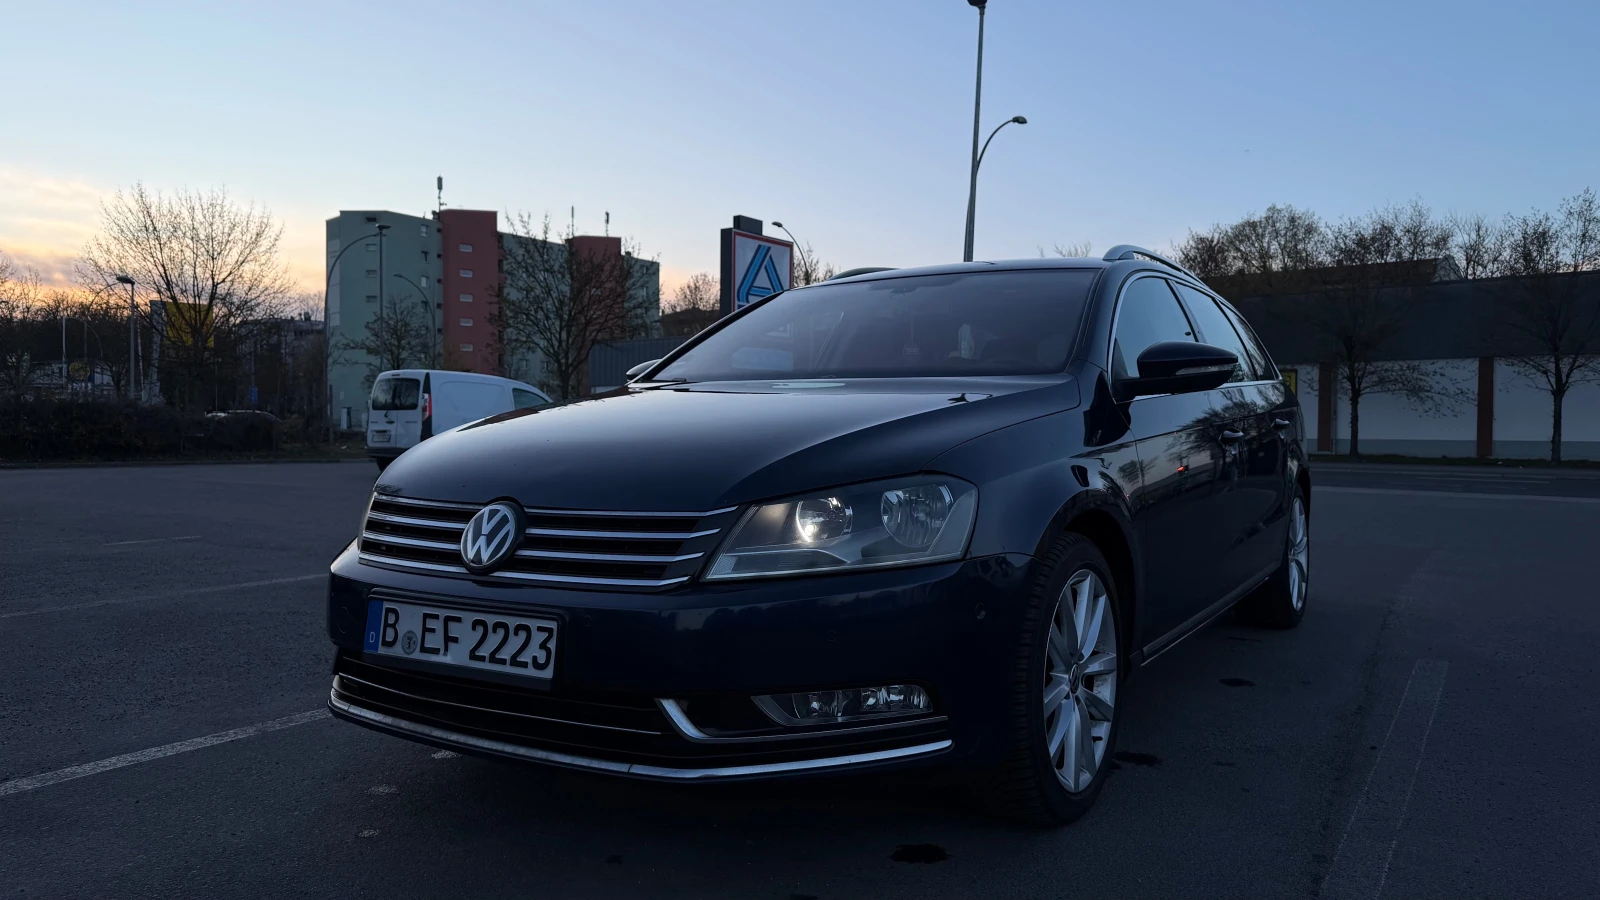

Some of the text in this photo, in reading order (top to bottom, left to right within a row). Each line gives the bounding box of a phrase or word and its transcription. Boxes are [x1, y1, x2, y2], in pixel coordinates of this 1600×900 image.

[462, 506, 515, 566] VW
[369, 632, 376, 643] D
[381, 607, 400, 648] B
[419, 612, 463, 656] EF
[469, 619, 554, 671] 2223
